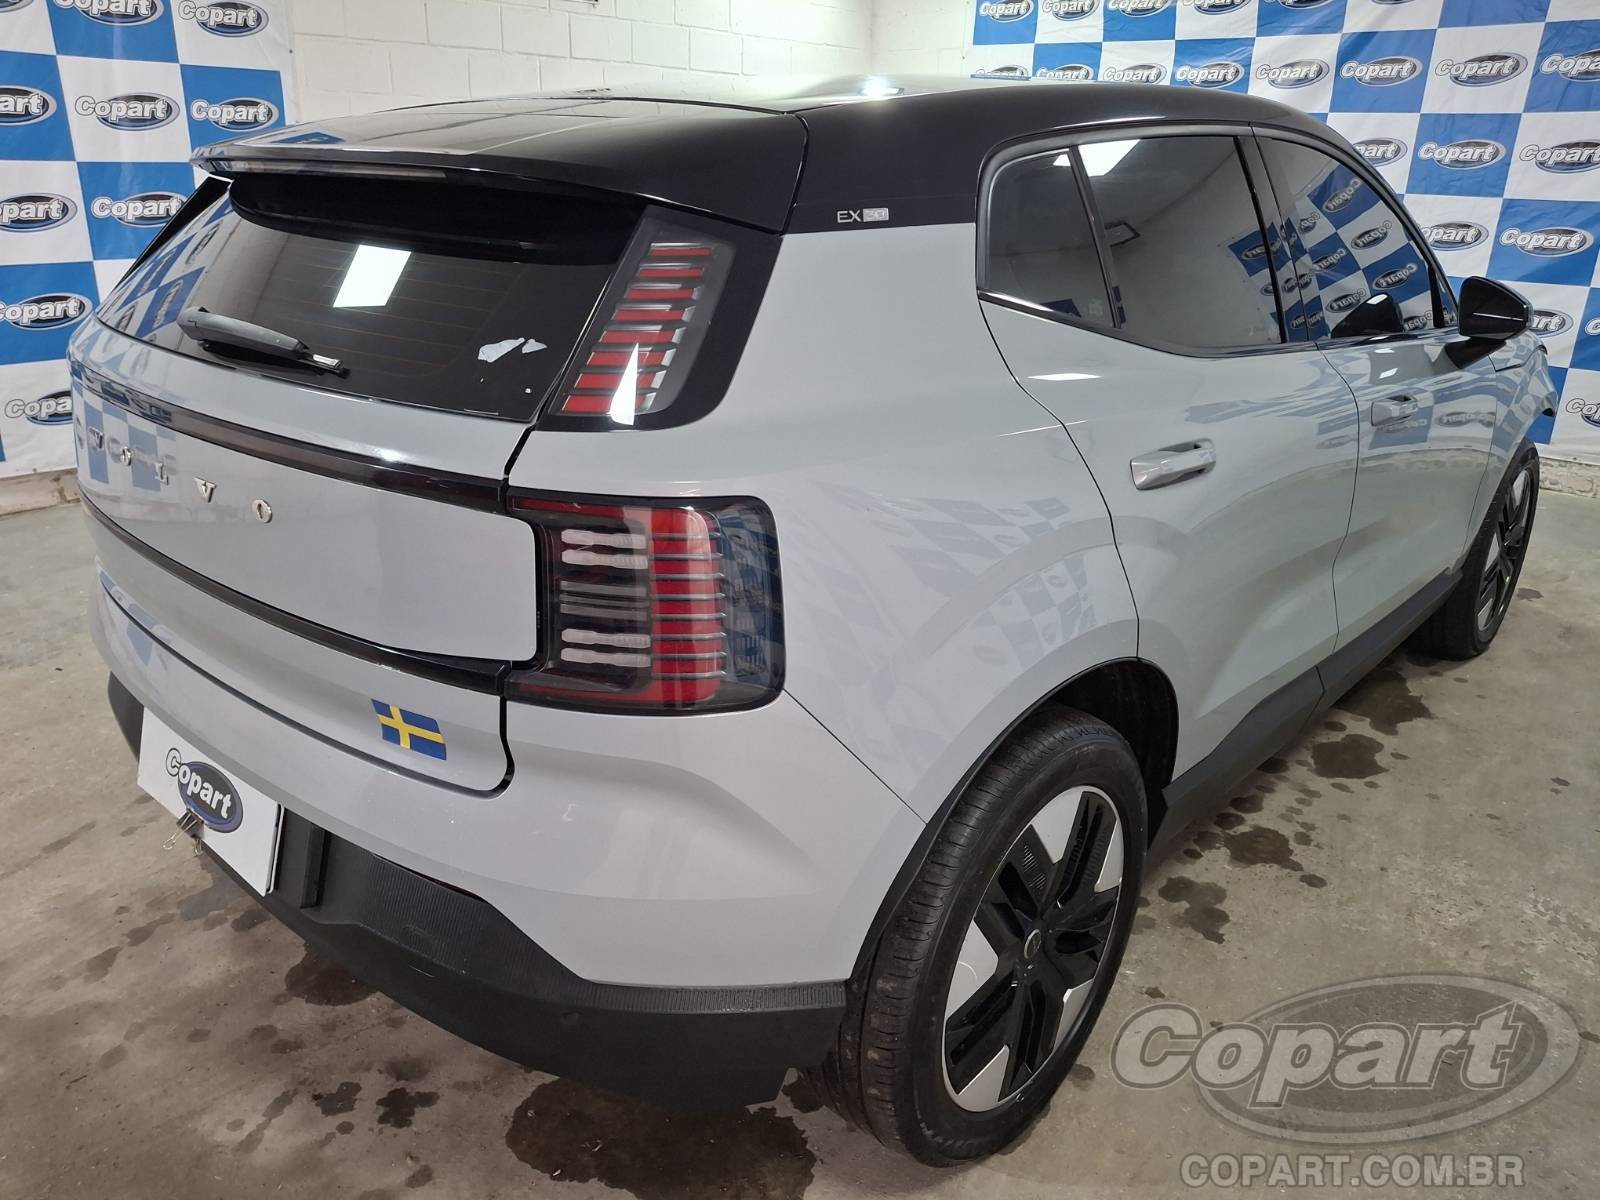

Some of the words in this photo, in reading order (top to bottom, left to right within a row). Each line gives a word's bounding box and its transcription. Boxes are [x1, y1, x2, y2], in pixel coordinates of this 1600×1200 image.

[179, 1, 257, 26] Copart
[979, 0, 1028, 18] Copart
[1042, 0, 1092, 15] Copart
[1104, 66, 1159, 82] Copart
[1175, 64, 1239, 83] Copart
[1256, 63, 1319, 81] Copart
[1340, 60, 1414, 82] Copart
[1435, 57, 1516, 80] Copart
[1541, 53, 1600, 77] Copa
[0, 93, 43, 115] art
[75, 96, 168, 122] Copart
[191, 100, 269, 124] Copart
[1419, 142, 1496, 163] Copart
[0, 199, 63, 224] part
[91, 196, 182, 222] Copart
[1422, 226, 1482, 244] opart
[1501, 228, 1584, 250] Copart
[4, 395, 73, 420] Copa
[165, 747, 233, 819] Copart
